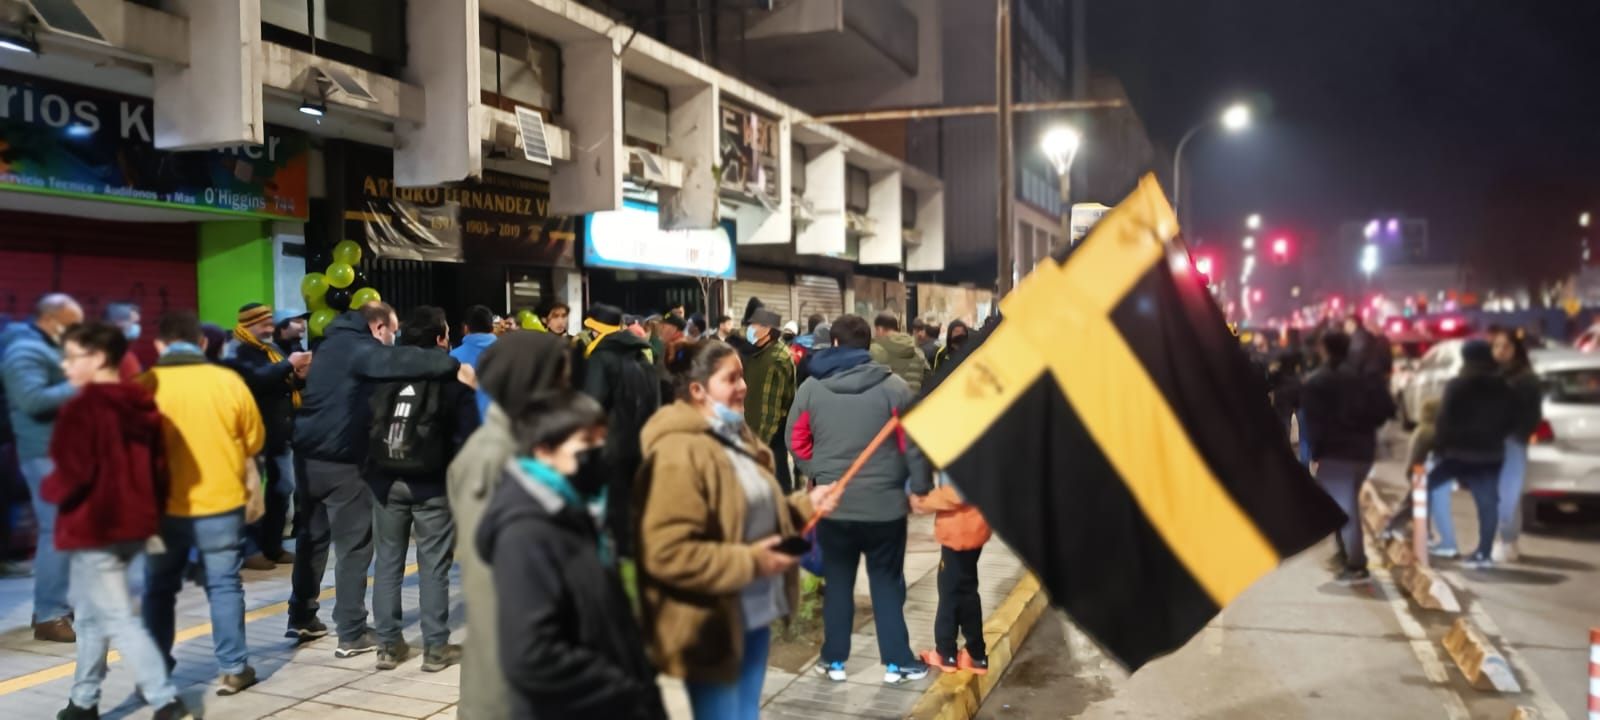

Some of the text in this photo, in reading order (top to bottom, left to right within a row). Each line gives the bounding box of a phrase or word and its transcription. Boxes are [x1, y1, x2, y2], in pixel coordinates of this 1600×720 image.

[0, 173, 45, 187] ervicio
[204, 187, 266, 211] O'Higgins
[444, 186, 532, 216] FERNANDEZ
